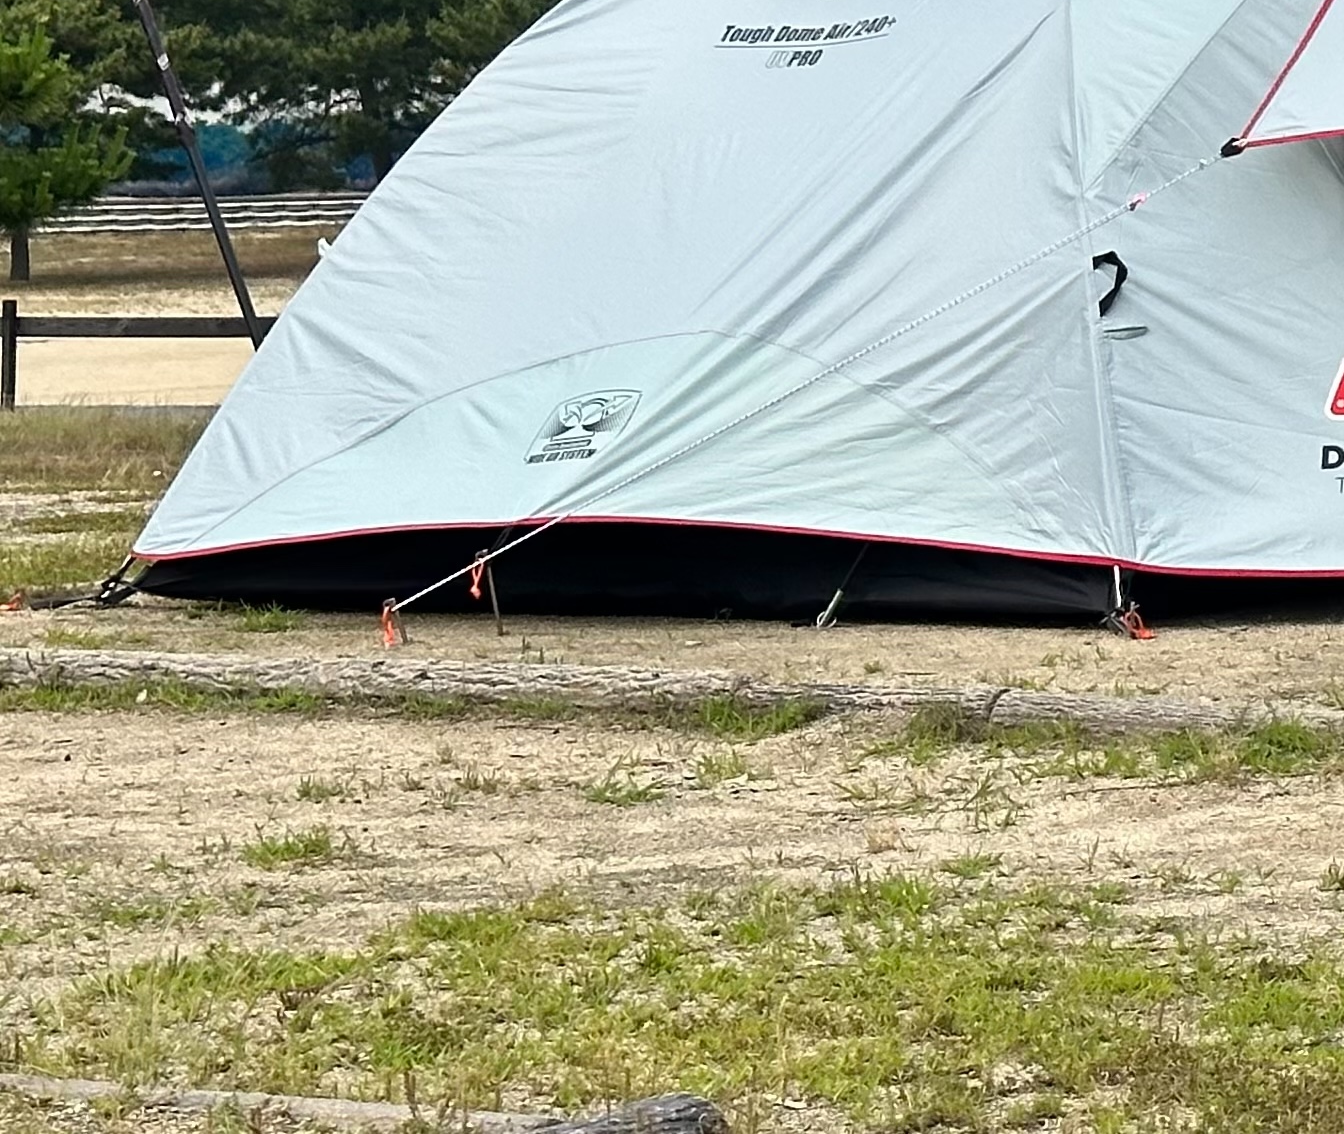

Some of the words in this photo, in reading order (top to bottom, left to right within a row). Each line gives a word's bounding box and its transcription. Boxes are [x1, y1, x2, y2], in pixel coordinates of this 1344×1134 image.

[720, 25, 775, 44] Tough
[773, 25, 825, 42] Dome
[823, 15, 897, 41] Air/240+
